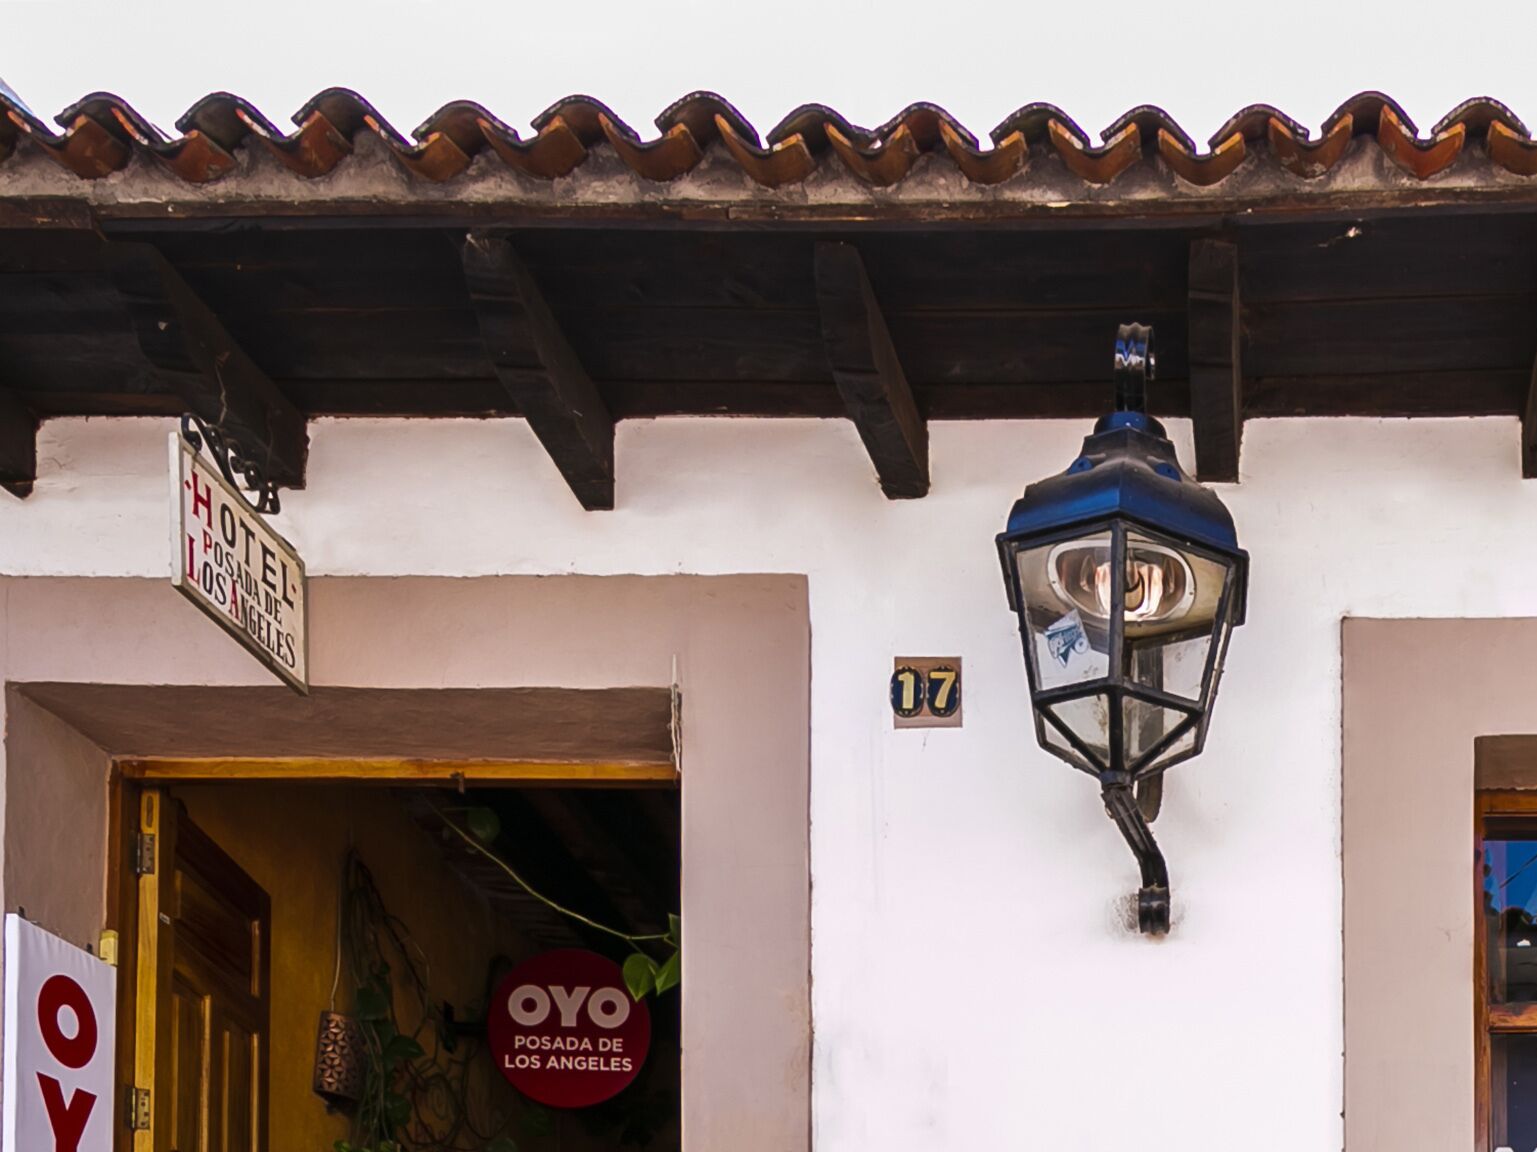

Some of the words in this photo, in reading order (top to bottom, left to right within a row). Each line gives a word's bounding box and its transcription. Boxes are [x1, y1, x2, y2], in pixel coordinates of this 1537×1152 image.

[191, 469, 294, 610] HOTEL
[202, 528, 262, 606] POSADA
[264, 588, 283, 625] DE
[186, 533, 227, 606] LOS
[228, 579, 296, 669] ANGELES
[898, 671, 956, 709] 17
[508, 984, 630, 1029] OYO
[504, 1054, 541, 1069] LOS
[546, 1055, 633, 1072] ANGELES
[514, 1035, 593, 1051] POSADA
[599, 1038, 623, 1052] DE
